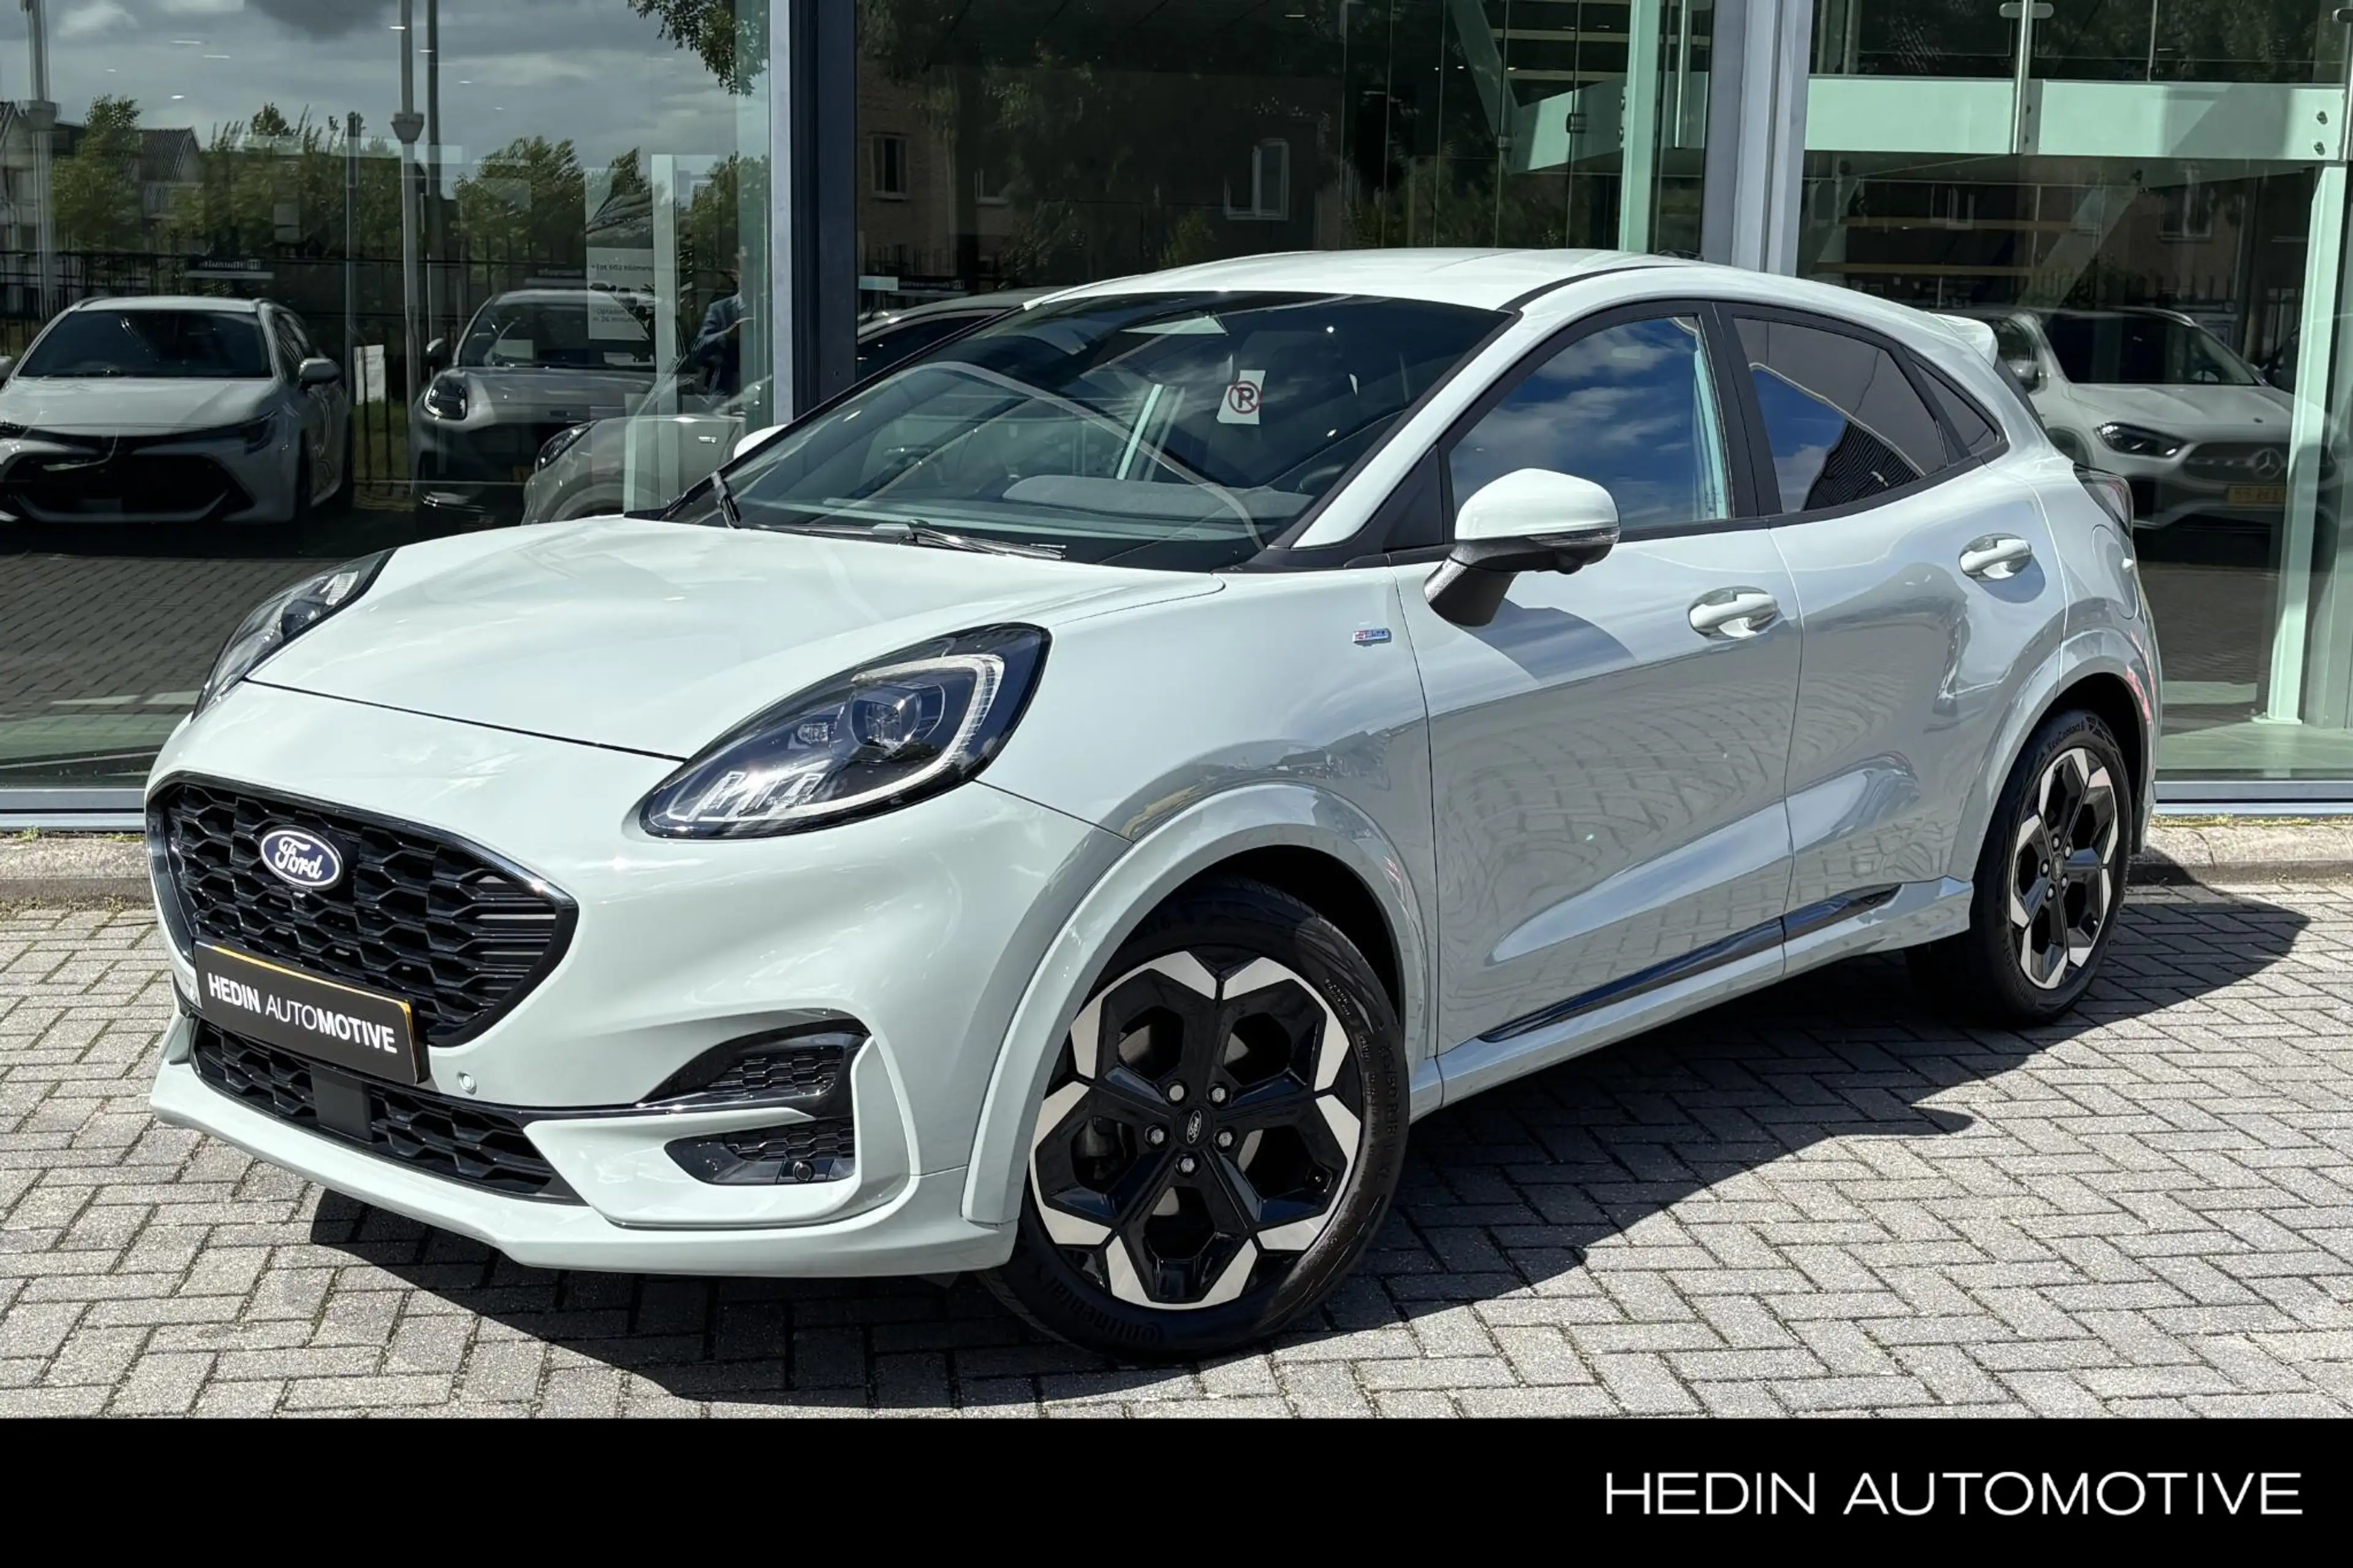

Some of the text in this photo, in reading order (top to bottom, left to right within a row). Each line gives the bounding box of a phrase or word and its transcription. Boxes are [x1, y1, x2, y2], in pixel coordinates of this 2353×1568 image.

[275, 836, 322, 879] Ford
[207, 972, 398, 1054] HEDIN AUTOMOTIVE
